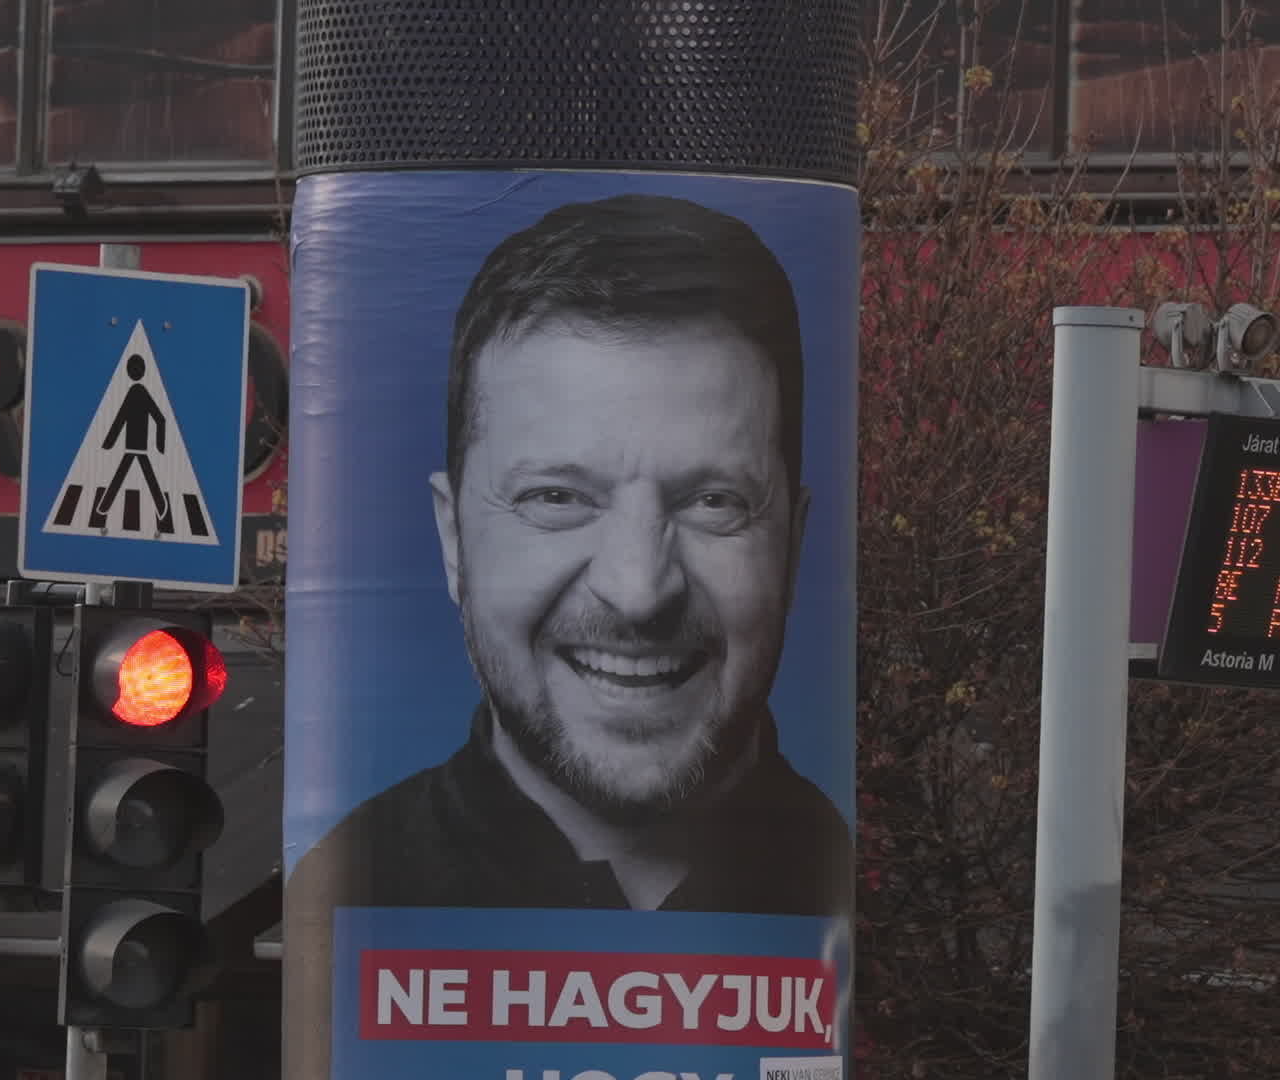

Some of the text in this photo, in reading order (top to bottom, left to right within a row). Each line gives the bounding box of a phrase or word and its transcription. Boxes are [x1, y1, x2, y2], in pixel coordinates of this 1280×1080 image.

[1242, 433, 1280, 455] Járat
[1230, 503, 1271, 534] 107
[1223, 536, 1264, 568] 112
[1207, 603, 1225, 633] 5
[1200, 650, 1275, 671] Astoria M
[376, 968, 832, 1044] NE HAGYJUK,
